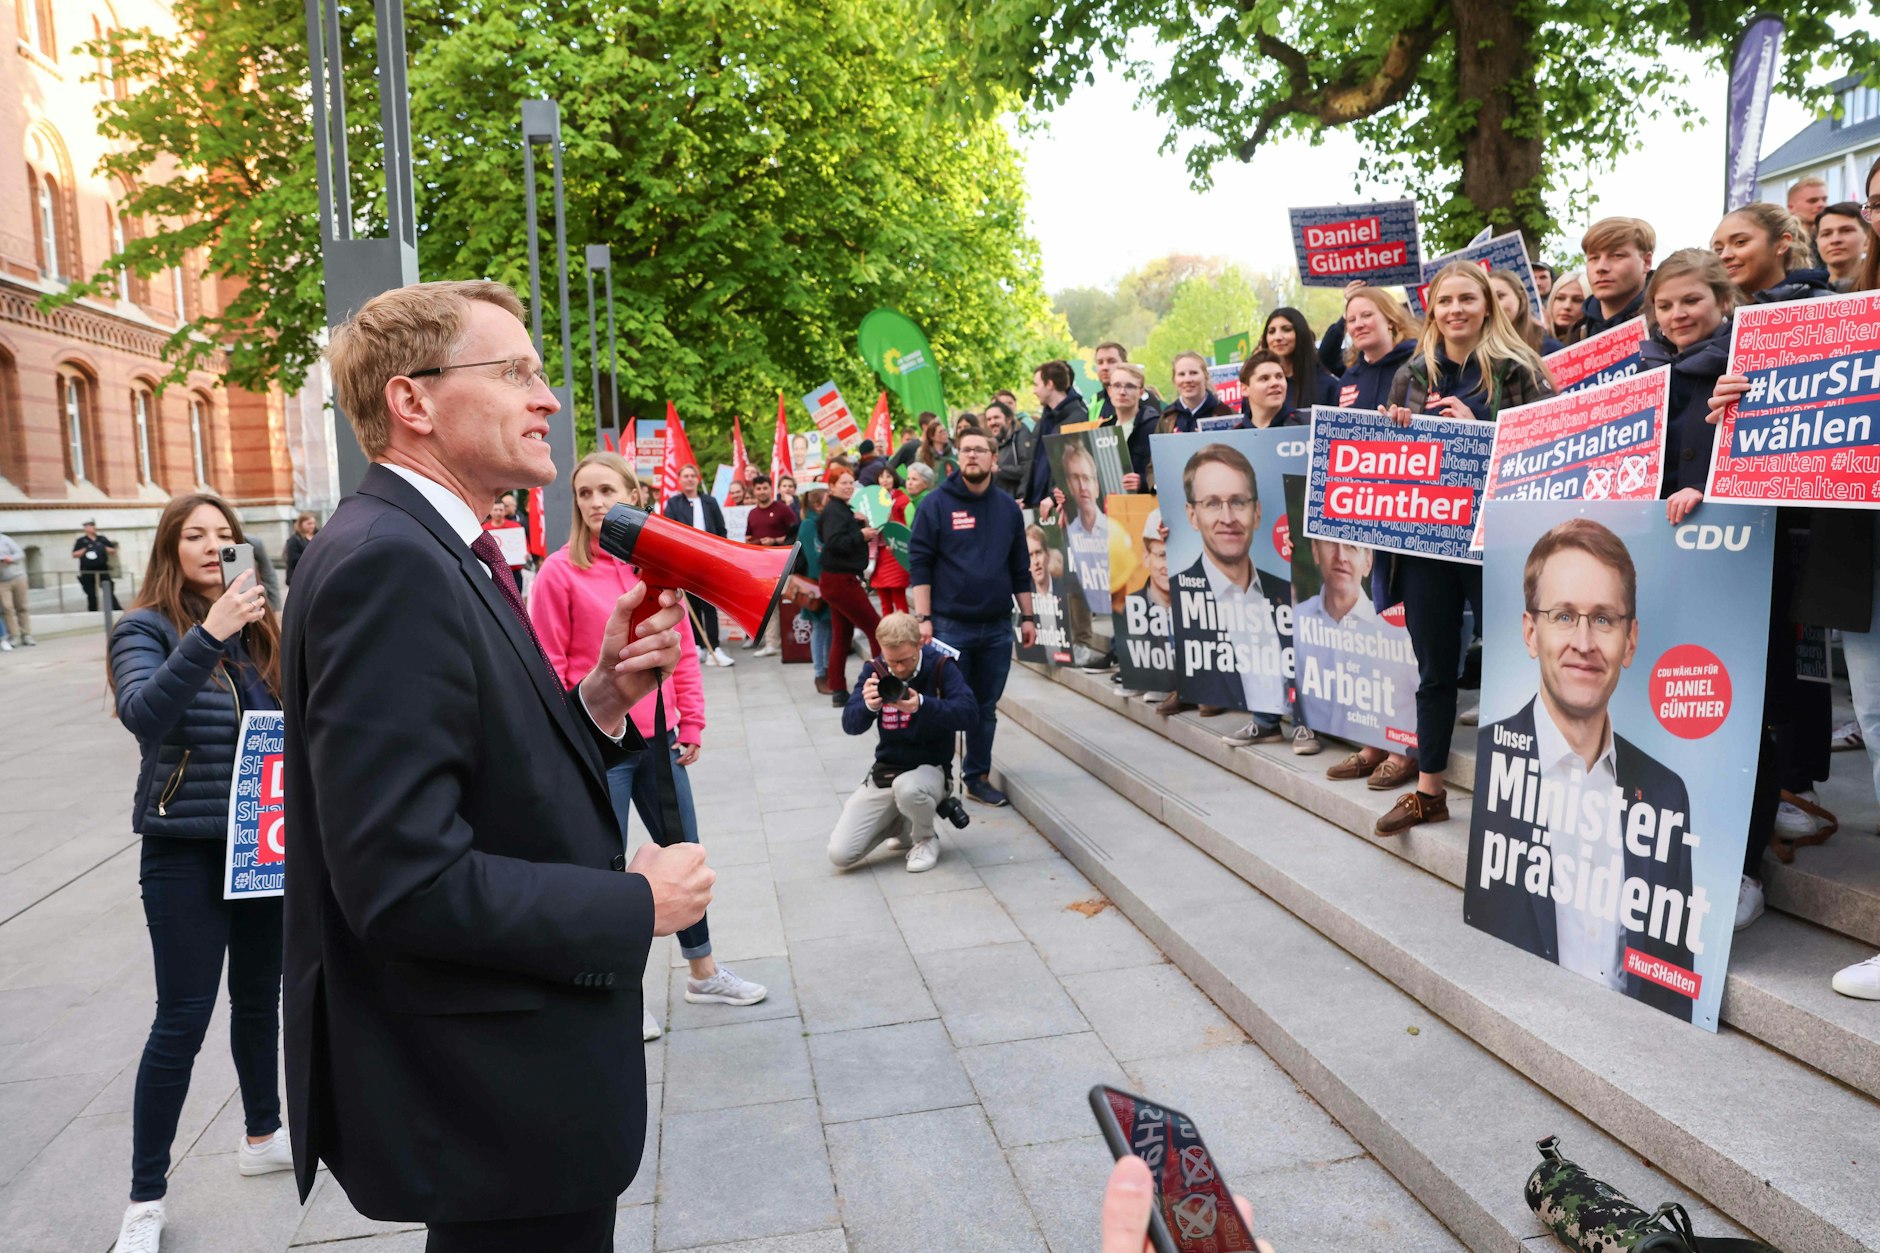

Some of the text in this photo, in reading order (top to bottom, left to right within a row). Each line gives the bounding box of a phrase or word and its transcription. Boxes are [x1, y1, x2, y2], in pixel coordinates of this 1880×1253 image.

[1307, 218, 1379, 248] Daniel
[1310, 247, 1403, 273] Günther
[1095, 436, 1119, 448] CDU
[1738, 410, 1872, 453] wählen
[1334, 444, 1438, 476] Daniel
[1501, 419, 1648, 477] #kurSHalten
[1495, 476, 1579, 500] ählen
[1715, 474, 1866, 500] #kurSHalten
[1329, 486, 1469, 520] Günther
[1675, 524, 1751, 551] CDU
[1178, 574, 1206, 588] Unser
[1299, 616, 1418, 666] Klimaschut
[1346, 660, 1360, 673] der
[1657, 663, 1719, 678] CDU WÄHLEN FÜR
[1302, 655, 1396, 718] Arbeit
[1665, 679, 1715, 698] DANIEL
[1346, 711, 1380, 728] schafft.
[1659, 698, 1725, 719] GÜNTHER
[1493, 724, 1534, 751] Unser
[1486, 751, 1701, 865] Minister-
[1480, 827, 1711, 956] präsident
[1627, 953, 1696, 995] #kurSHalten
